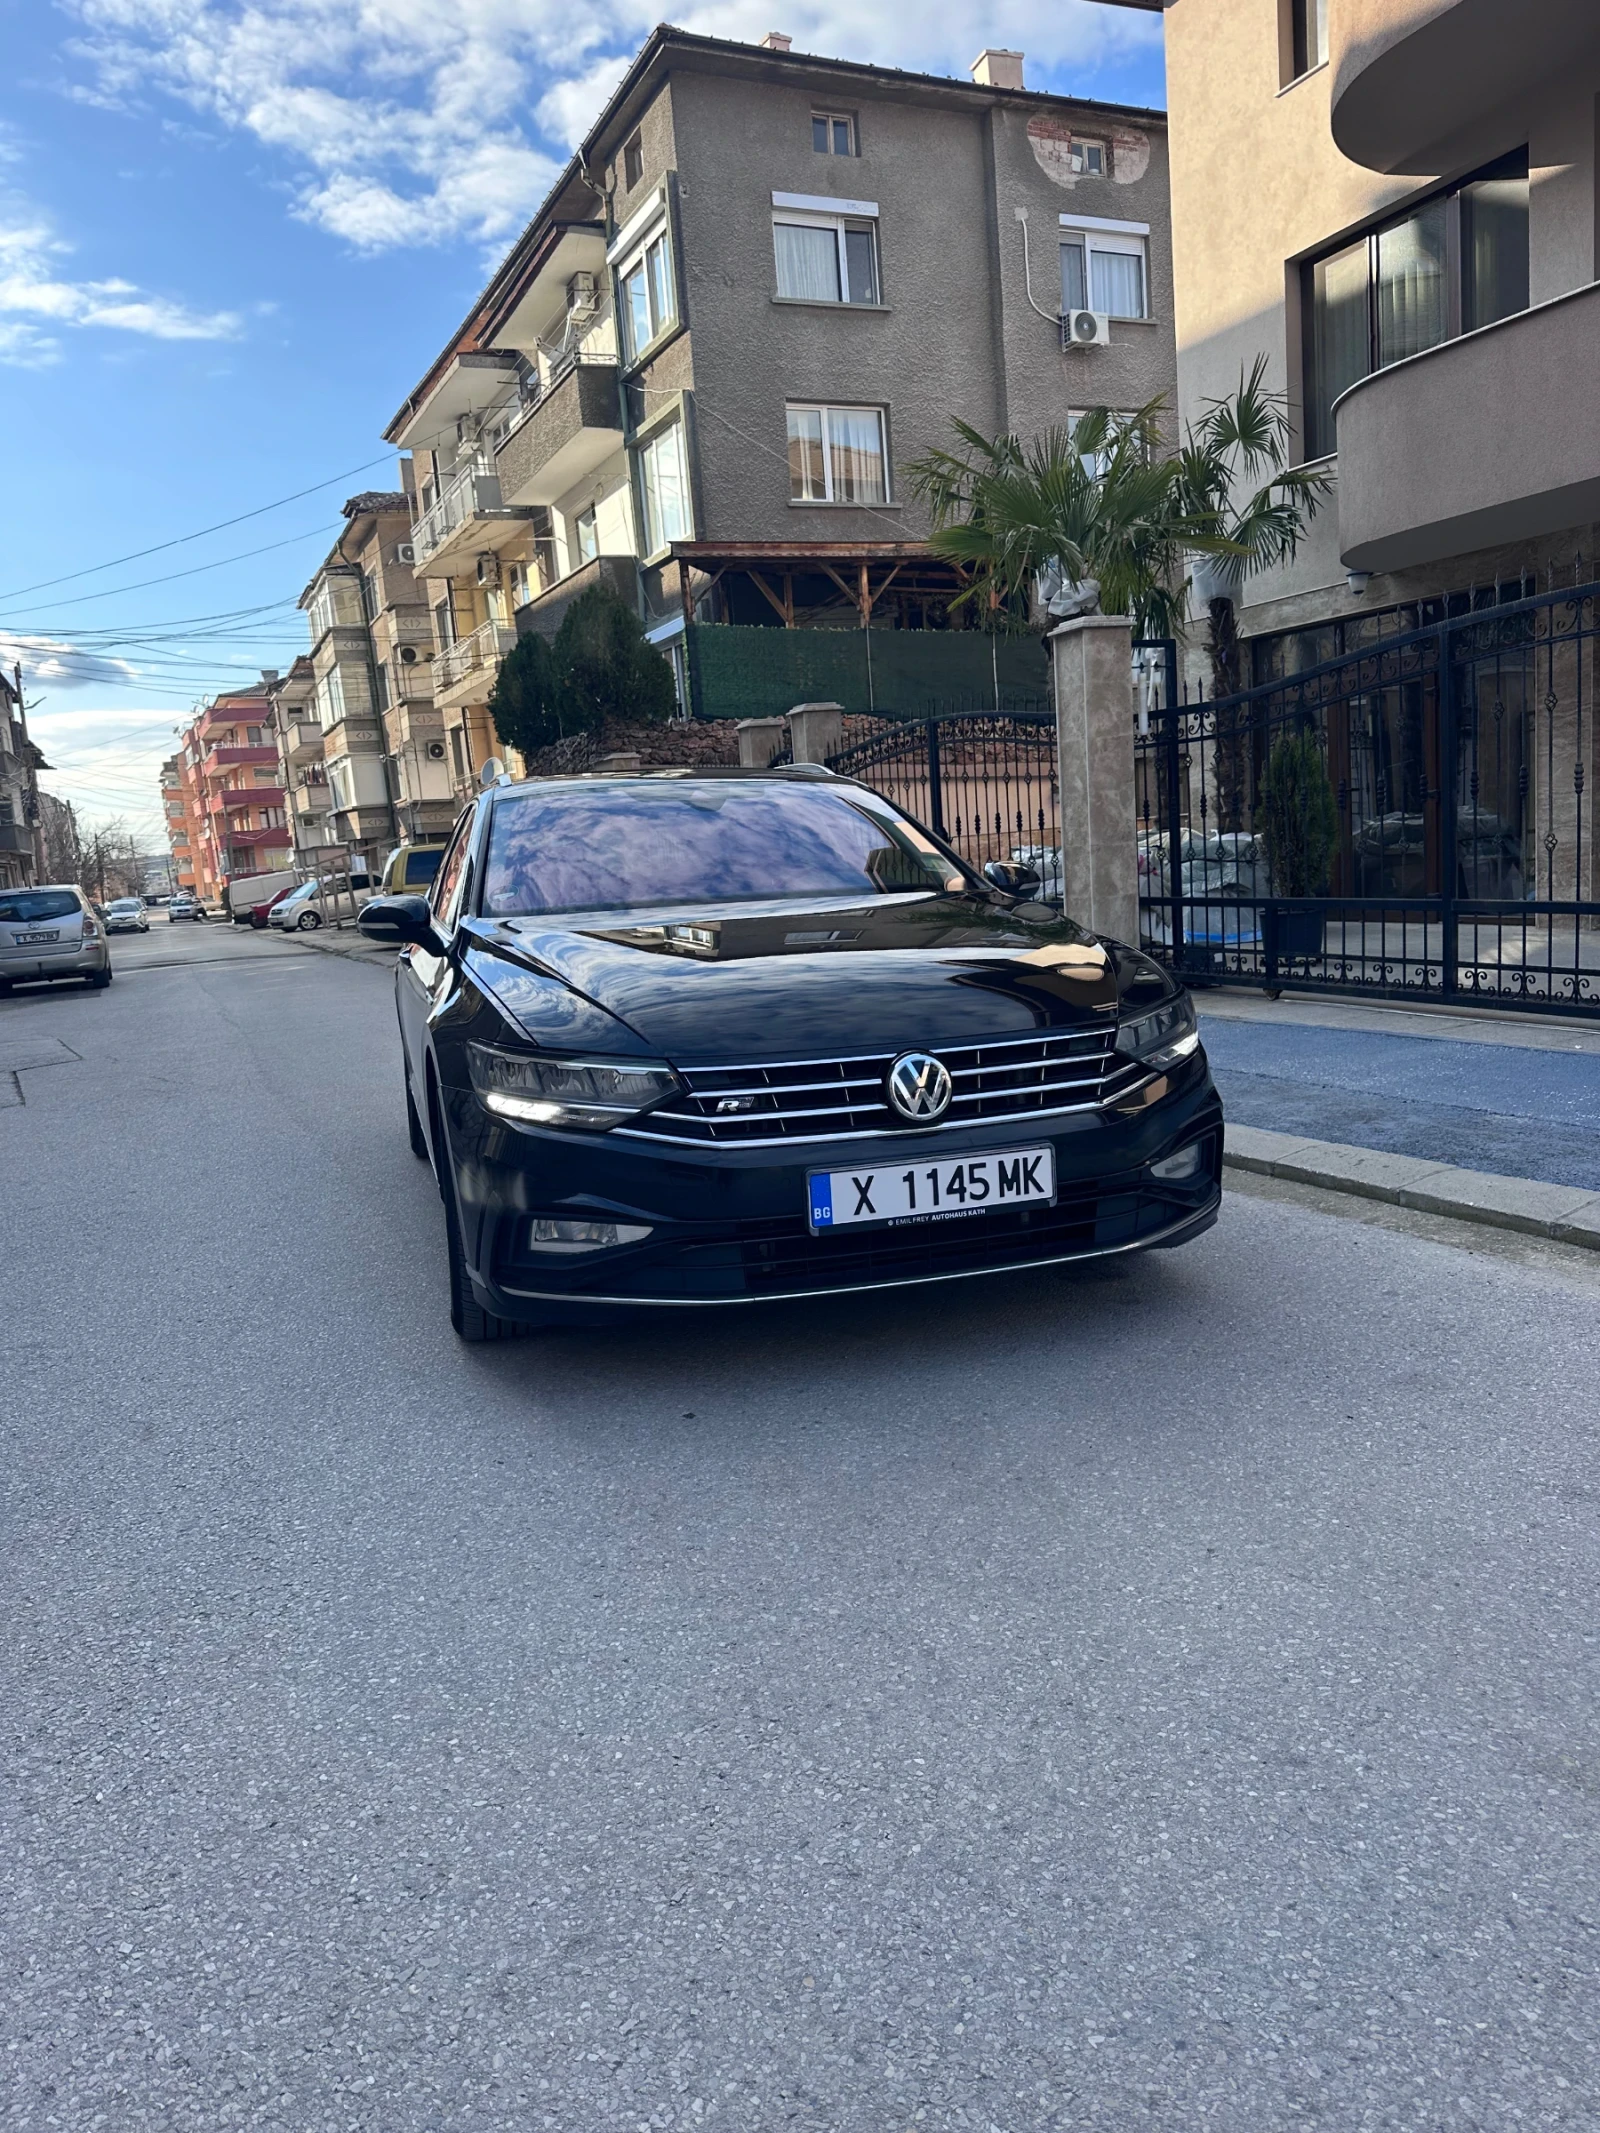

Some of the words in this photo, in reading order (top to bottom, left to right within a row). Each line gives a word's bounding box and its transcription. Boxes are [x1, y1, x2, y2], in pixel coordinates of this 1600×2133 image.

[889, 1053, 952, 1121] VW
[851, 1175, 876, 1216] X
[902, 1162, 990, 1209] 1145
[997, 1155, 1045, 1198] MK
[813, 1207, 831, 1220] BG
[895, 1218, 912, 1226] EMIL
[913, 1215, 930, 1223] FREY
[931, 1211, 967, 1221] AUTOHAUS
[968, 1208, 986, 1217] KATH
